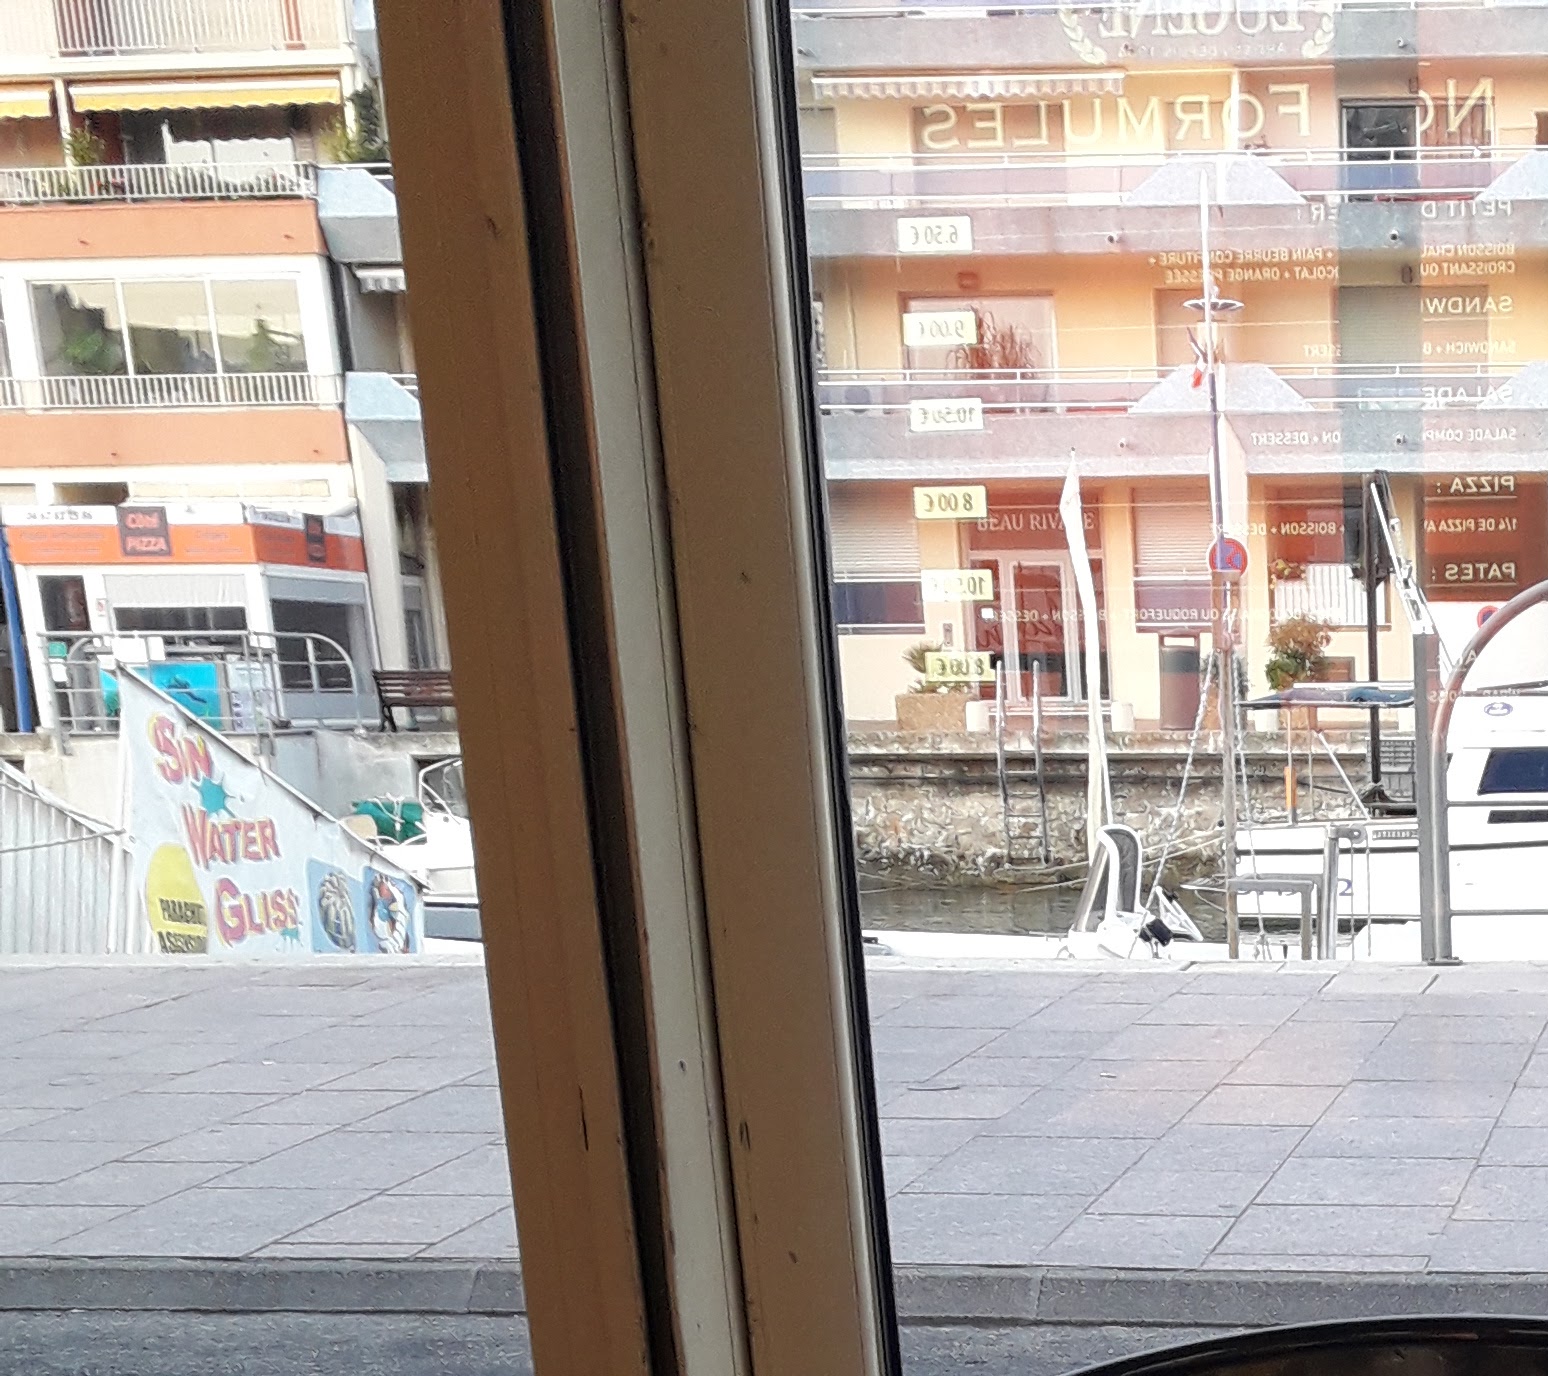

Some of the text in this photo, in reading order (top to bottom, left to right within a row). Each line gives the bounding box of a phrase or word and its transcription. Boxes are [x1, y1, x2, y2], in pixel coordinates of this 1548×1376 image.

[977, 510, 1096, 531] BEAU RIVE
[181, 803, 284, 870] WATER
